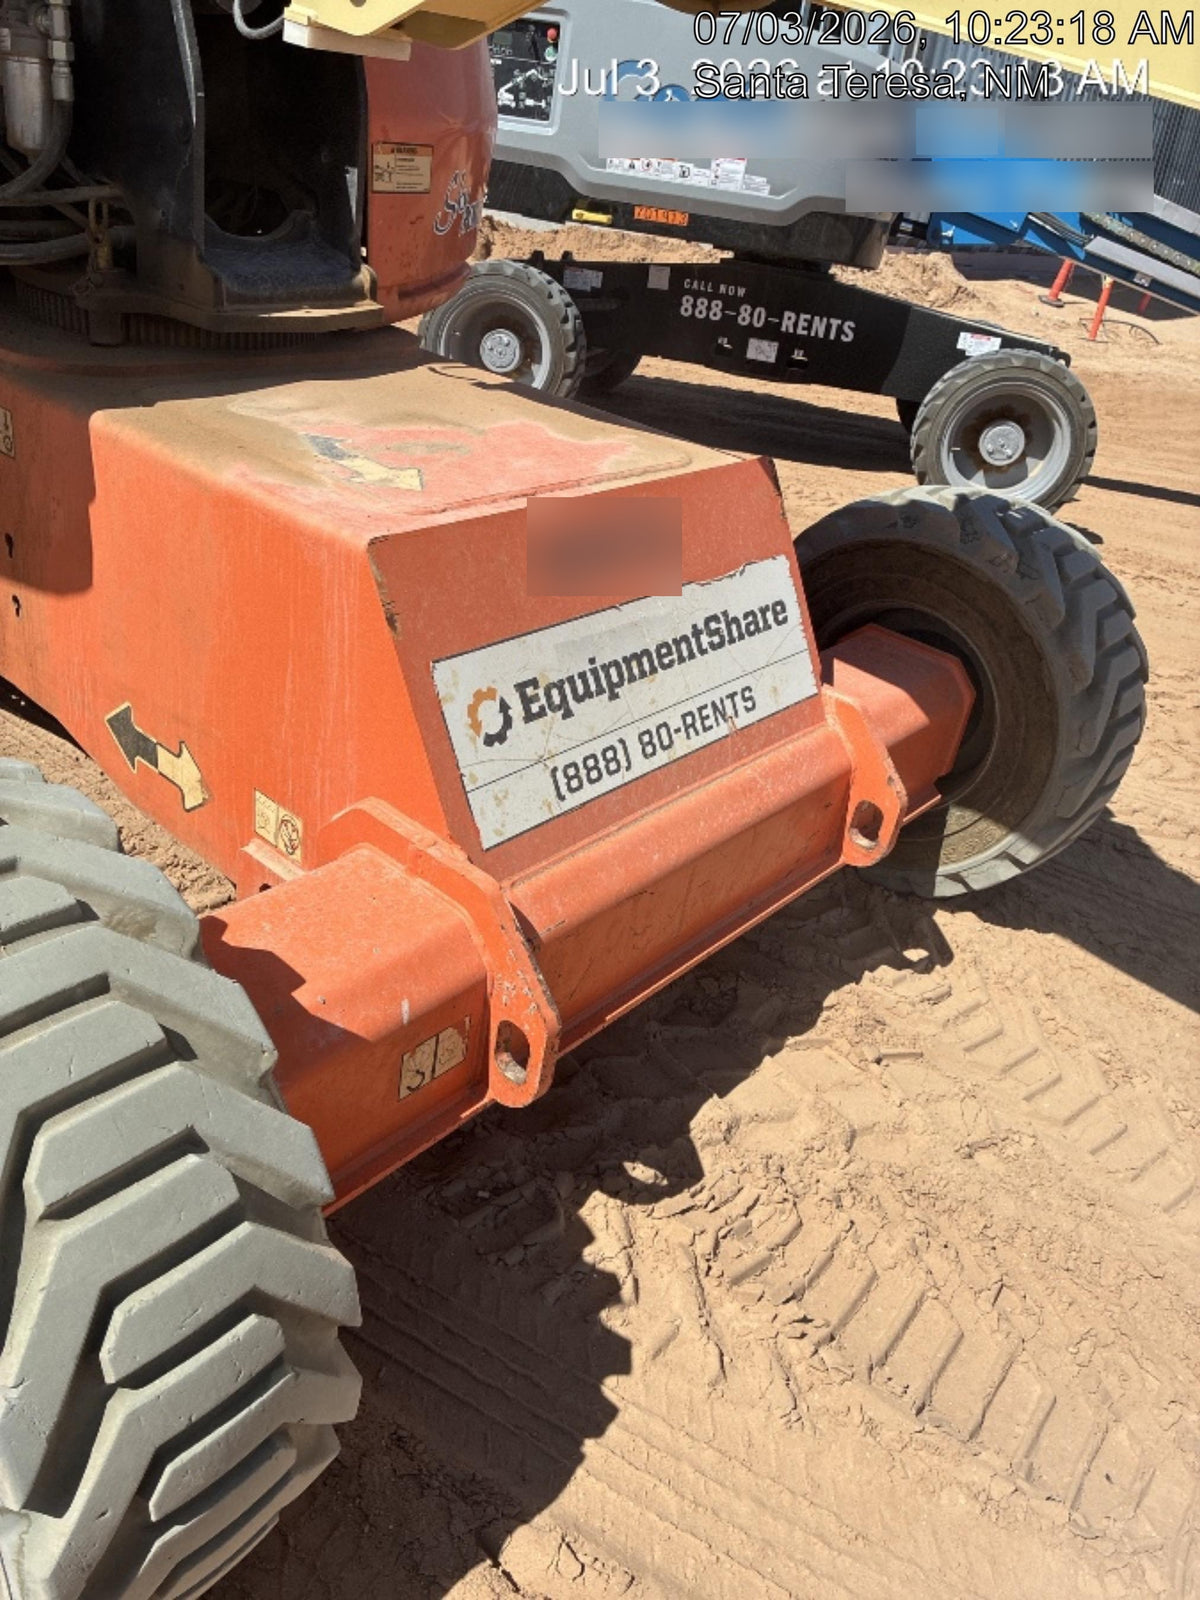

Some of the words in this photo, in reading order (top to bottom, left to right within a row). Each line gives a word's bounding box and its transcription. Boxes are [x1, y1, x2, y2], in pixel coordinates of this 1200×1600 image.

[680, 295, 857, 343] 888-80-RENTS
[683, 278, 714, 293] CALL
[719, 283, 747, 298] NOW
[513, 598, 789, 725] EquipmentShare
[550, 736, 633, 803] (888)
[637, 685, 758, 762] 80-RENTS
